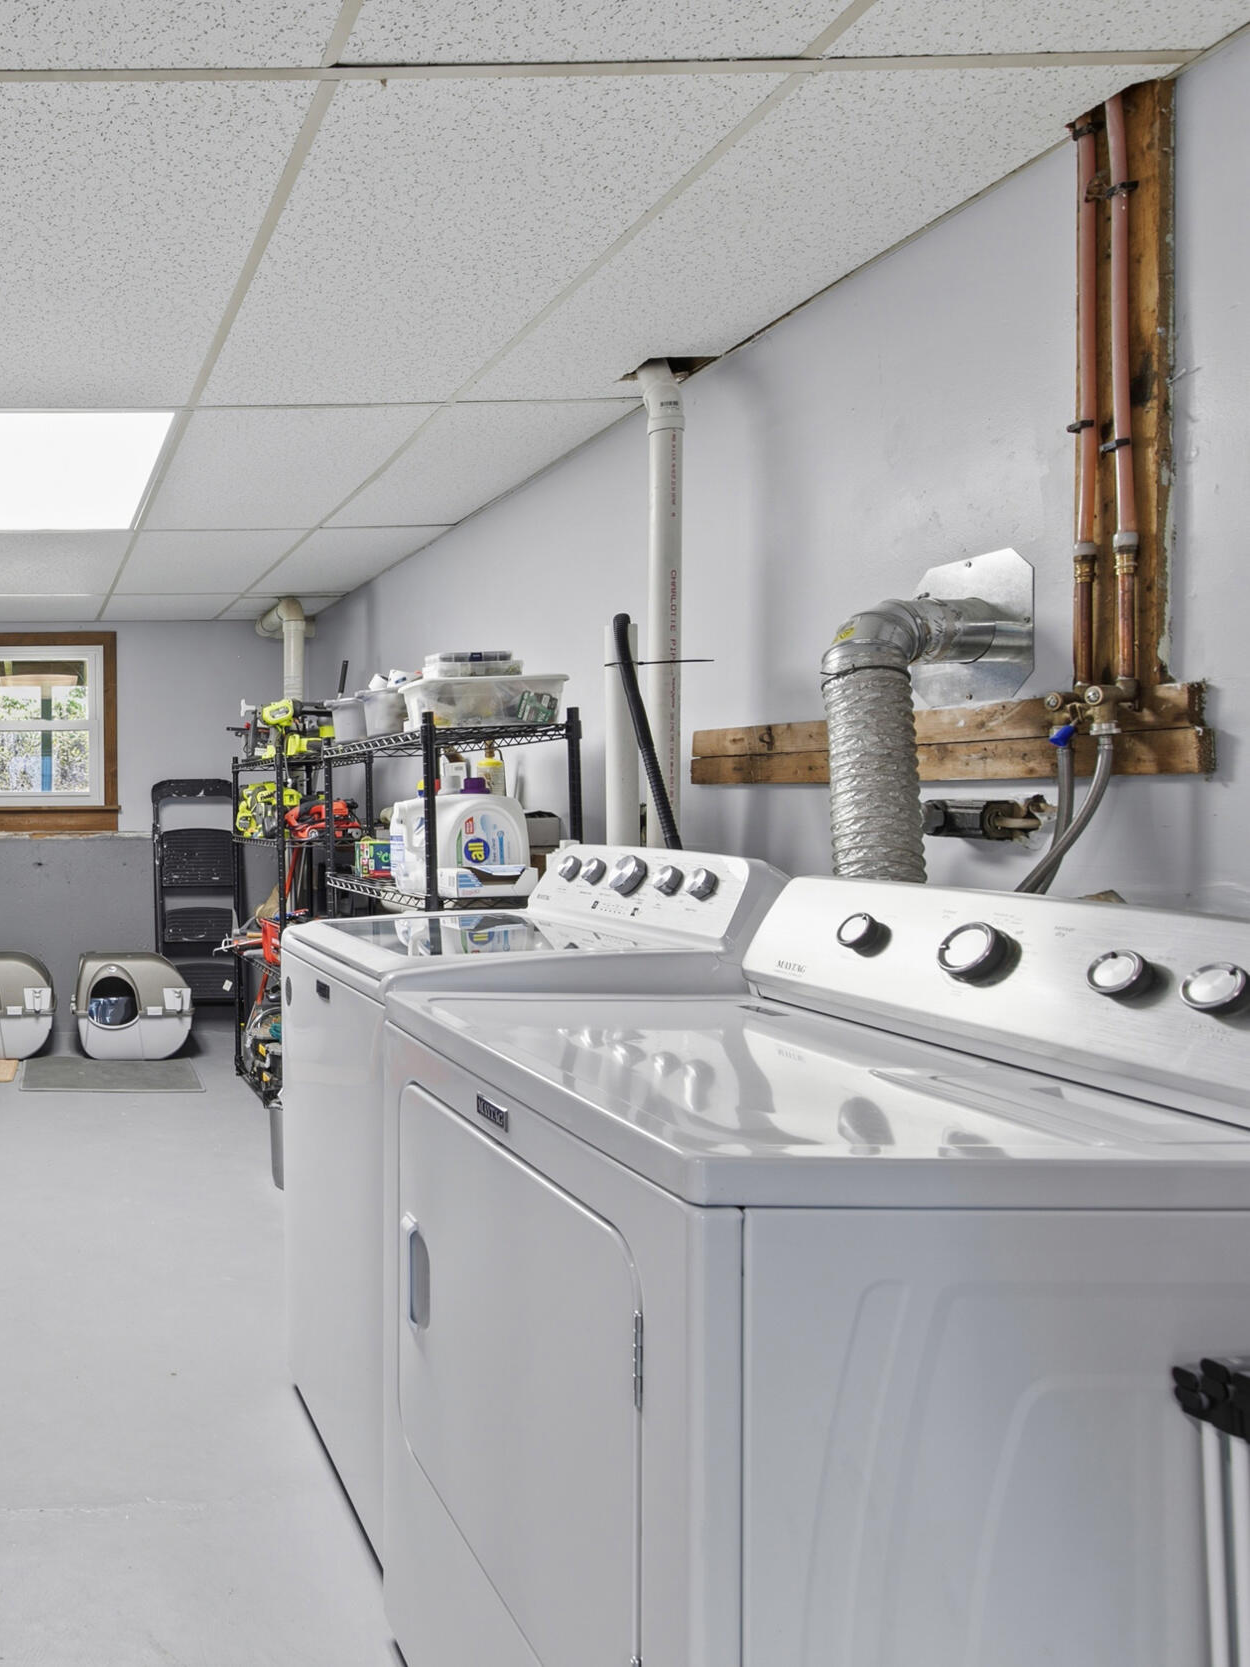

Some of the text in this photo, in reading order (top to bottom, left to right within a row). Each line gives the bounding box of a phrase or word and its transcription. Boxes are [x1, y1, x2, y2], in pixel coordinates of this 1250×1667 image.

[669, 569, 678, 632] CHARLOTTE
[669, 638, 678, 666] PIP
[467, 842, 485, 861] all
[776, 959, 807, 974] MAYTAG
[478, 1098, 503, 1125] MAYTAG
